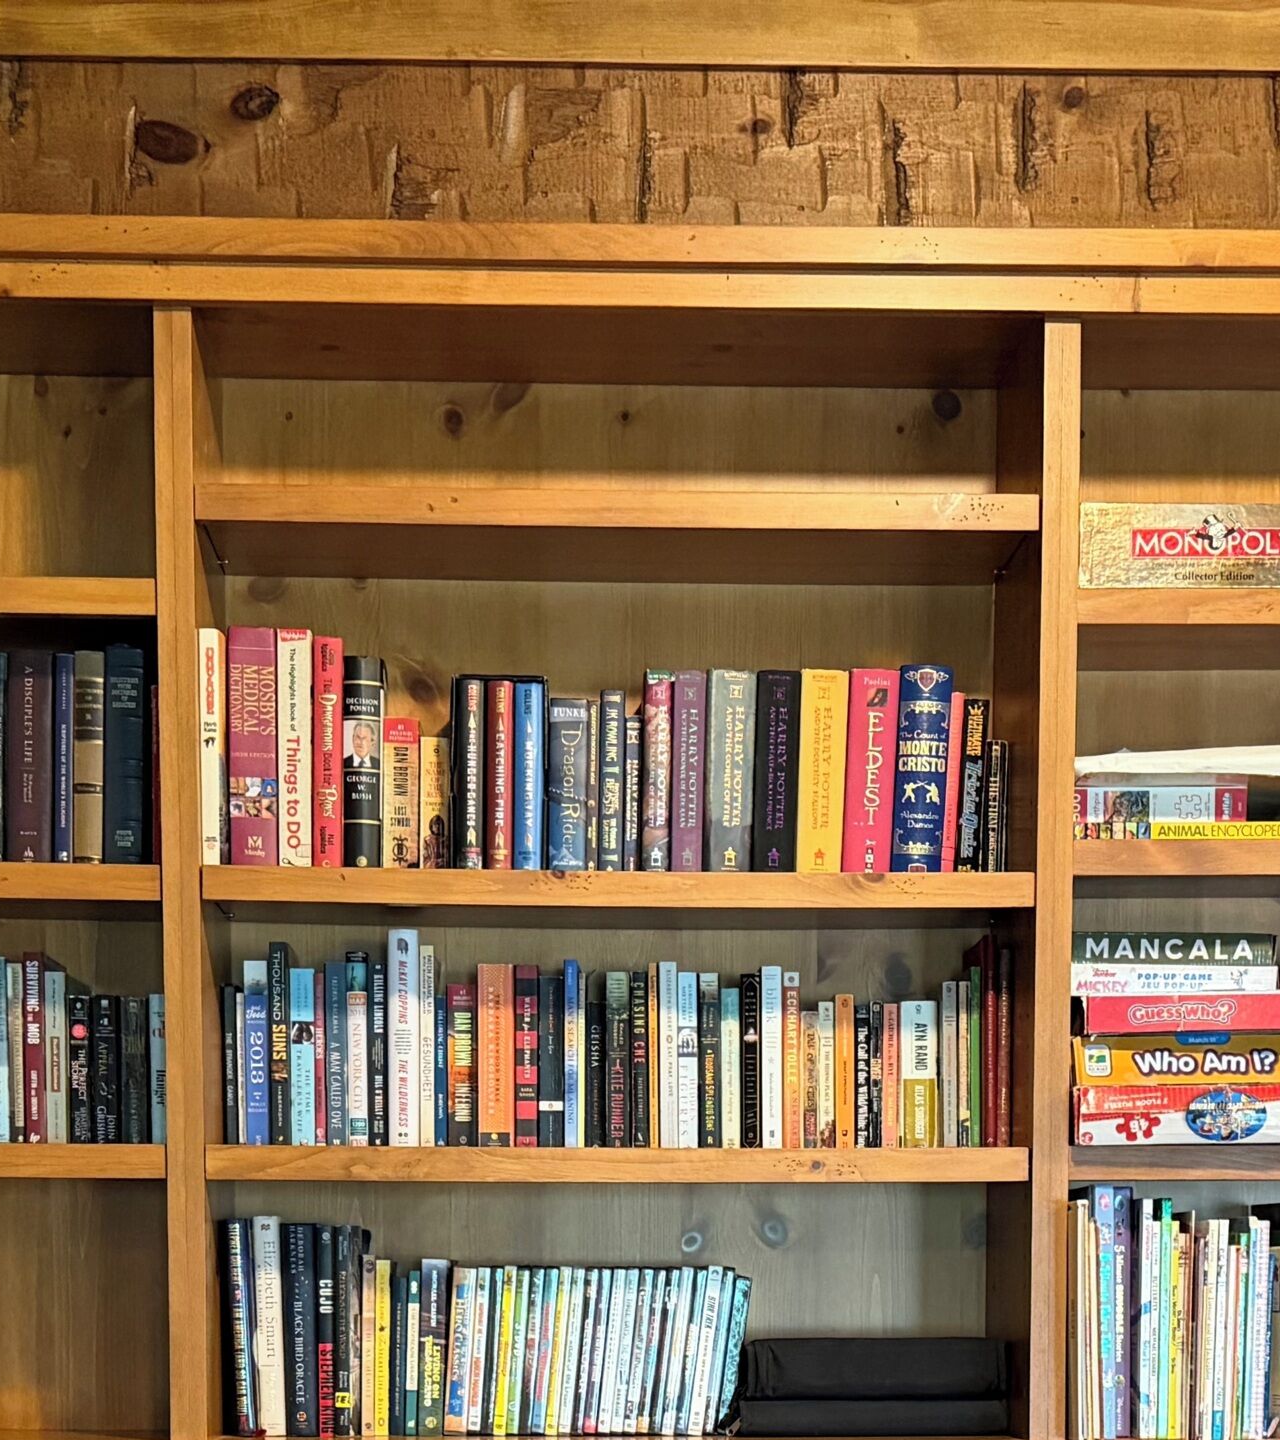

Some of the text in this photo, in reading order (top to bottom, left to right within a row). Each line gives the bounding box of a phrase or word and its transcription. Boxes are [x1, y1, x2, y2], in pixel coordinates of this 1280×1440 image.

[1175, 570, 1254, 582] Collector Edition
[230, 663, 242, 734] DICTIONARY
[243, 664, 258, 736] MEDICAL
[259, 666, 276, 736] MOSBY'S
[864, 677, 890, 686] Paolini
[24, 677, 33, 763] DISCIPLE'S LIFE
[606, 721, 618, 762] ROWLING
[899, 740, 947, 756] MONTE
[284, 736, 301, 794] Things
[393, 746, 409, 797] DAN BROWN
[560, 724, 583, 852] Dragon Rider
[688, 709, 699, 828] HARRY POTTER
[731, 705, 745, 827] HARRY POTTER
[864, 712, 884, 825] ELDEST
[899, 757, 946, 773] CRISTO
[287, 799, 300, 817] to
[287, 821, 301, 848] DO
[1157, 824, 1208, 837] ANIMAL
[1085, 938, 1254, 960] MANCALA
[1137, 973, 1177, 981] POP-UP
[26, 960, 39, 1045] SURVIVING MOB
[271, 951, 287, 1060] THOUSAND SUNS
[1076, 980, 1128, 992] MICKEY
[1130, 1001, 1236, 1023] Guess Who?
[249, 1031, 264, 1084] 2013
[590, 1025, 600, 1068] GEISHA
[633, 982, 645, 1064] CHASING CHE
[787, 991, 797, 1084] ECKHART TOLLE
[914, 1023, 929, 1071] AYN RAND
[330, 1051, 342, 1129] MAN CALLED OVE
[398, 989, 409, 1128] COPPINS THE WILDERNESS
[454, 1012, 473, 1122] DAN BROWN INFERNO
[1134, 1050, 1276, 1075] Who Am I?
[610, 1066, 624, 1138] KITE RUNNER
[263, 1241, 277, 1358] Elizabeth Smart
[294, 1301, 304, 1404] BLACK BIRD ORACLE
[319, 1279, 333, 1433] CUJO STEPHEN KING
